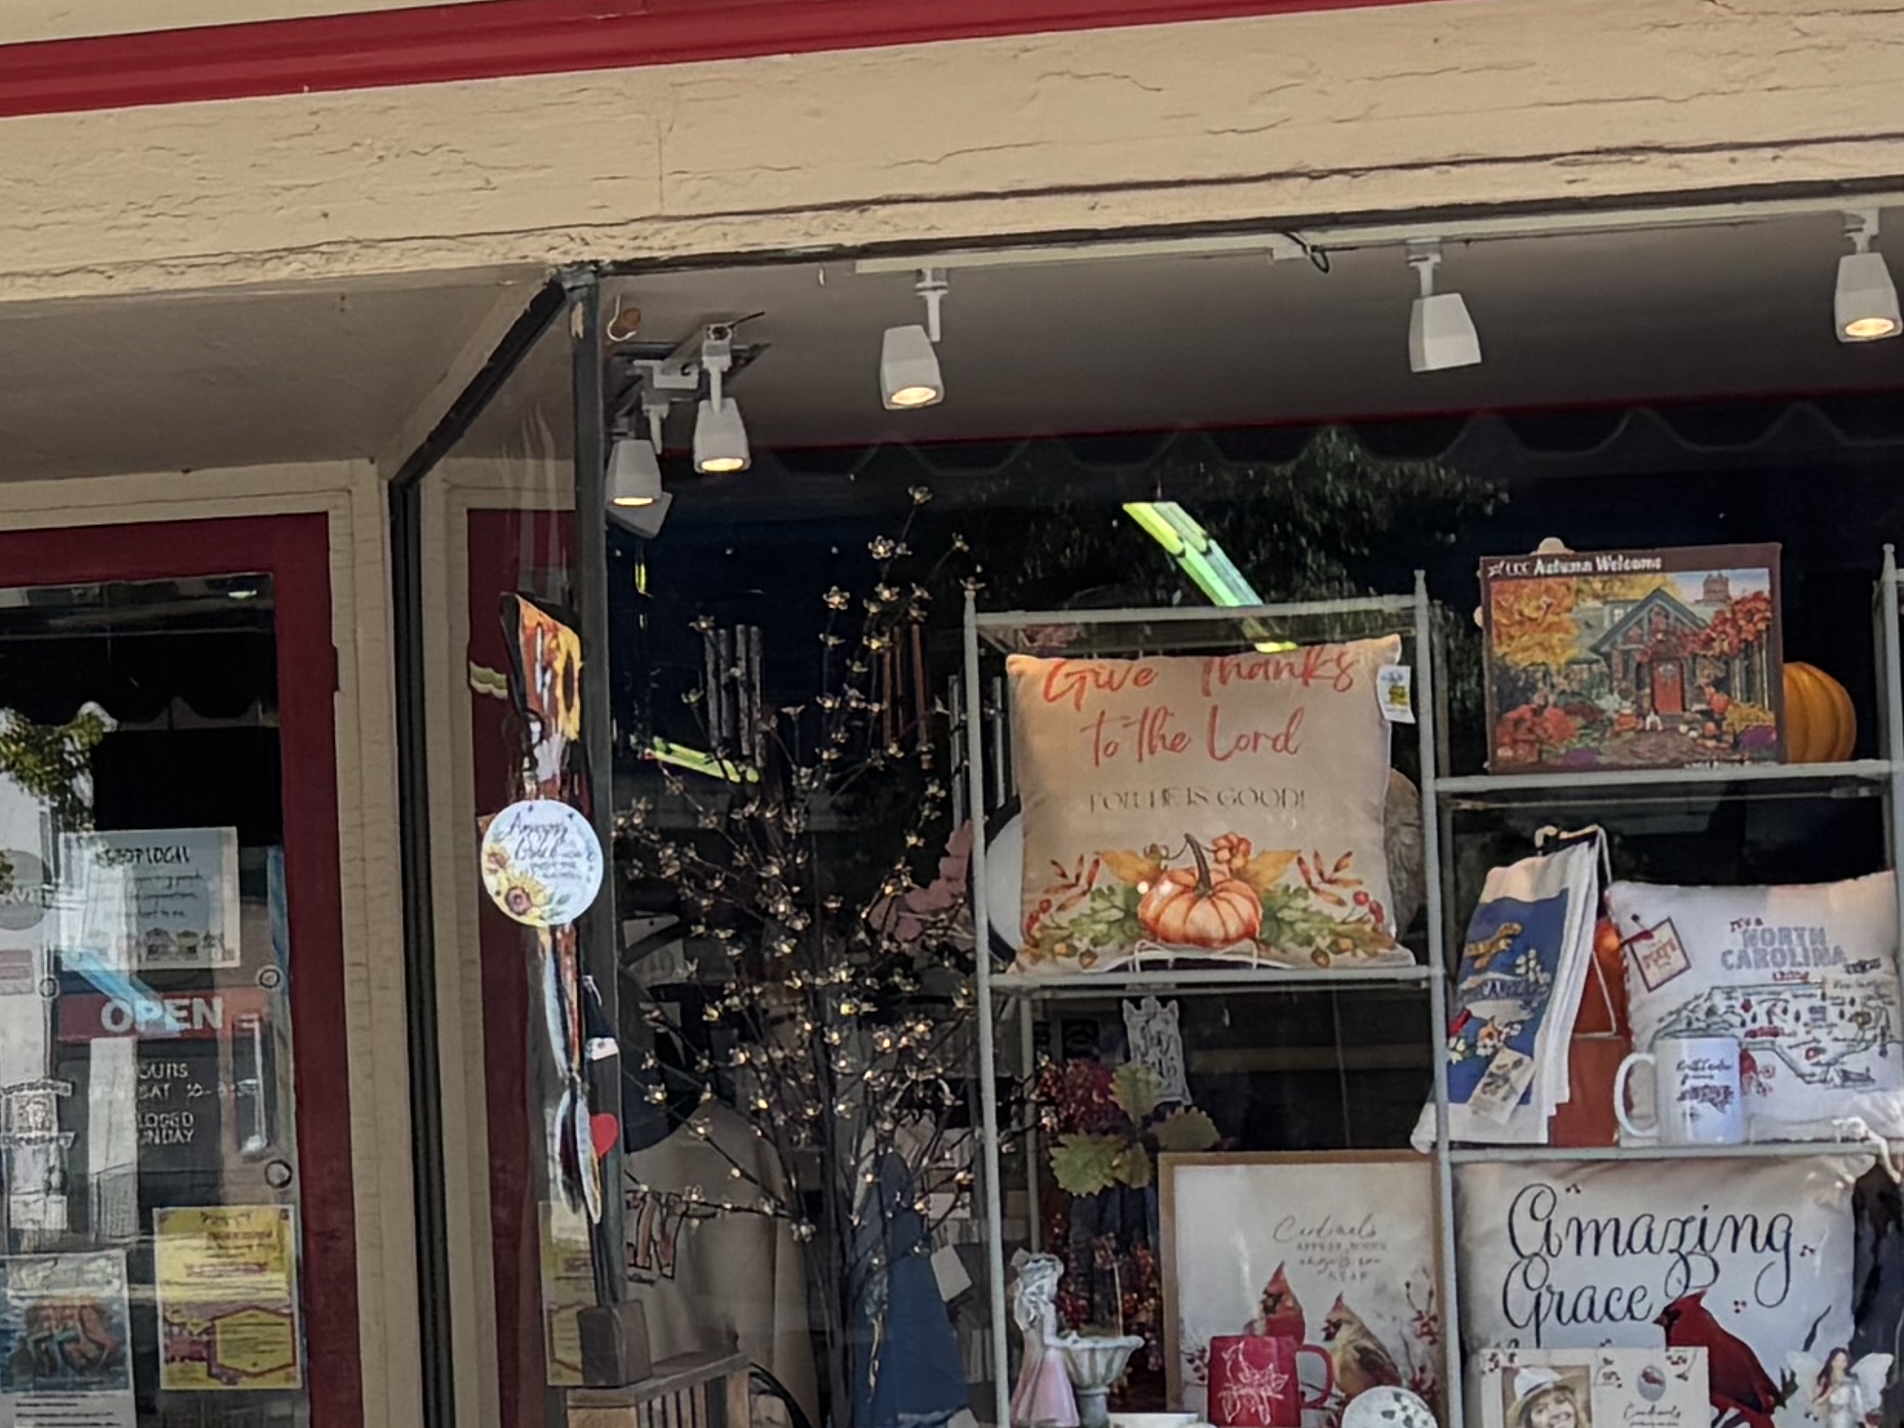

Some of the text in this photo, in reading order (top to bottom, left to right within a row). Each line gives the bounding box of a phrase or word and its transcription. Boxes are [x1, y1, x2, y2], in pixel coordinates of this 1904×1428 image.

[1533, 558, 1595, 573] Autumn
[1596, 554, 1663, 572] Welcome
[1043, 658, 1158, 712] Give
[1081, 709, 1119, 767] to
[1206, 704, 1306, 761] Lord
[1216, 785, 1307, 813] GOOD!
[1743, 926, 1827, 950] NORTH
[1720, 944, 1848, 971] CAROLINA
[100, 996, 224, 1032] OPEN
[1272, 1213, 1378, 1245] Cardinals
[1506, 1181, 1796, 1309] Amazing
[1501, 1253, 1656, 1349] Grace
